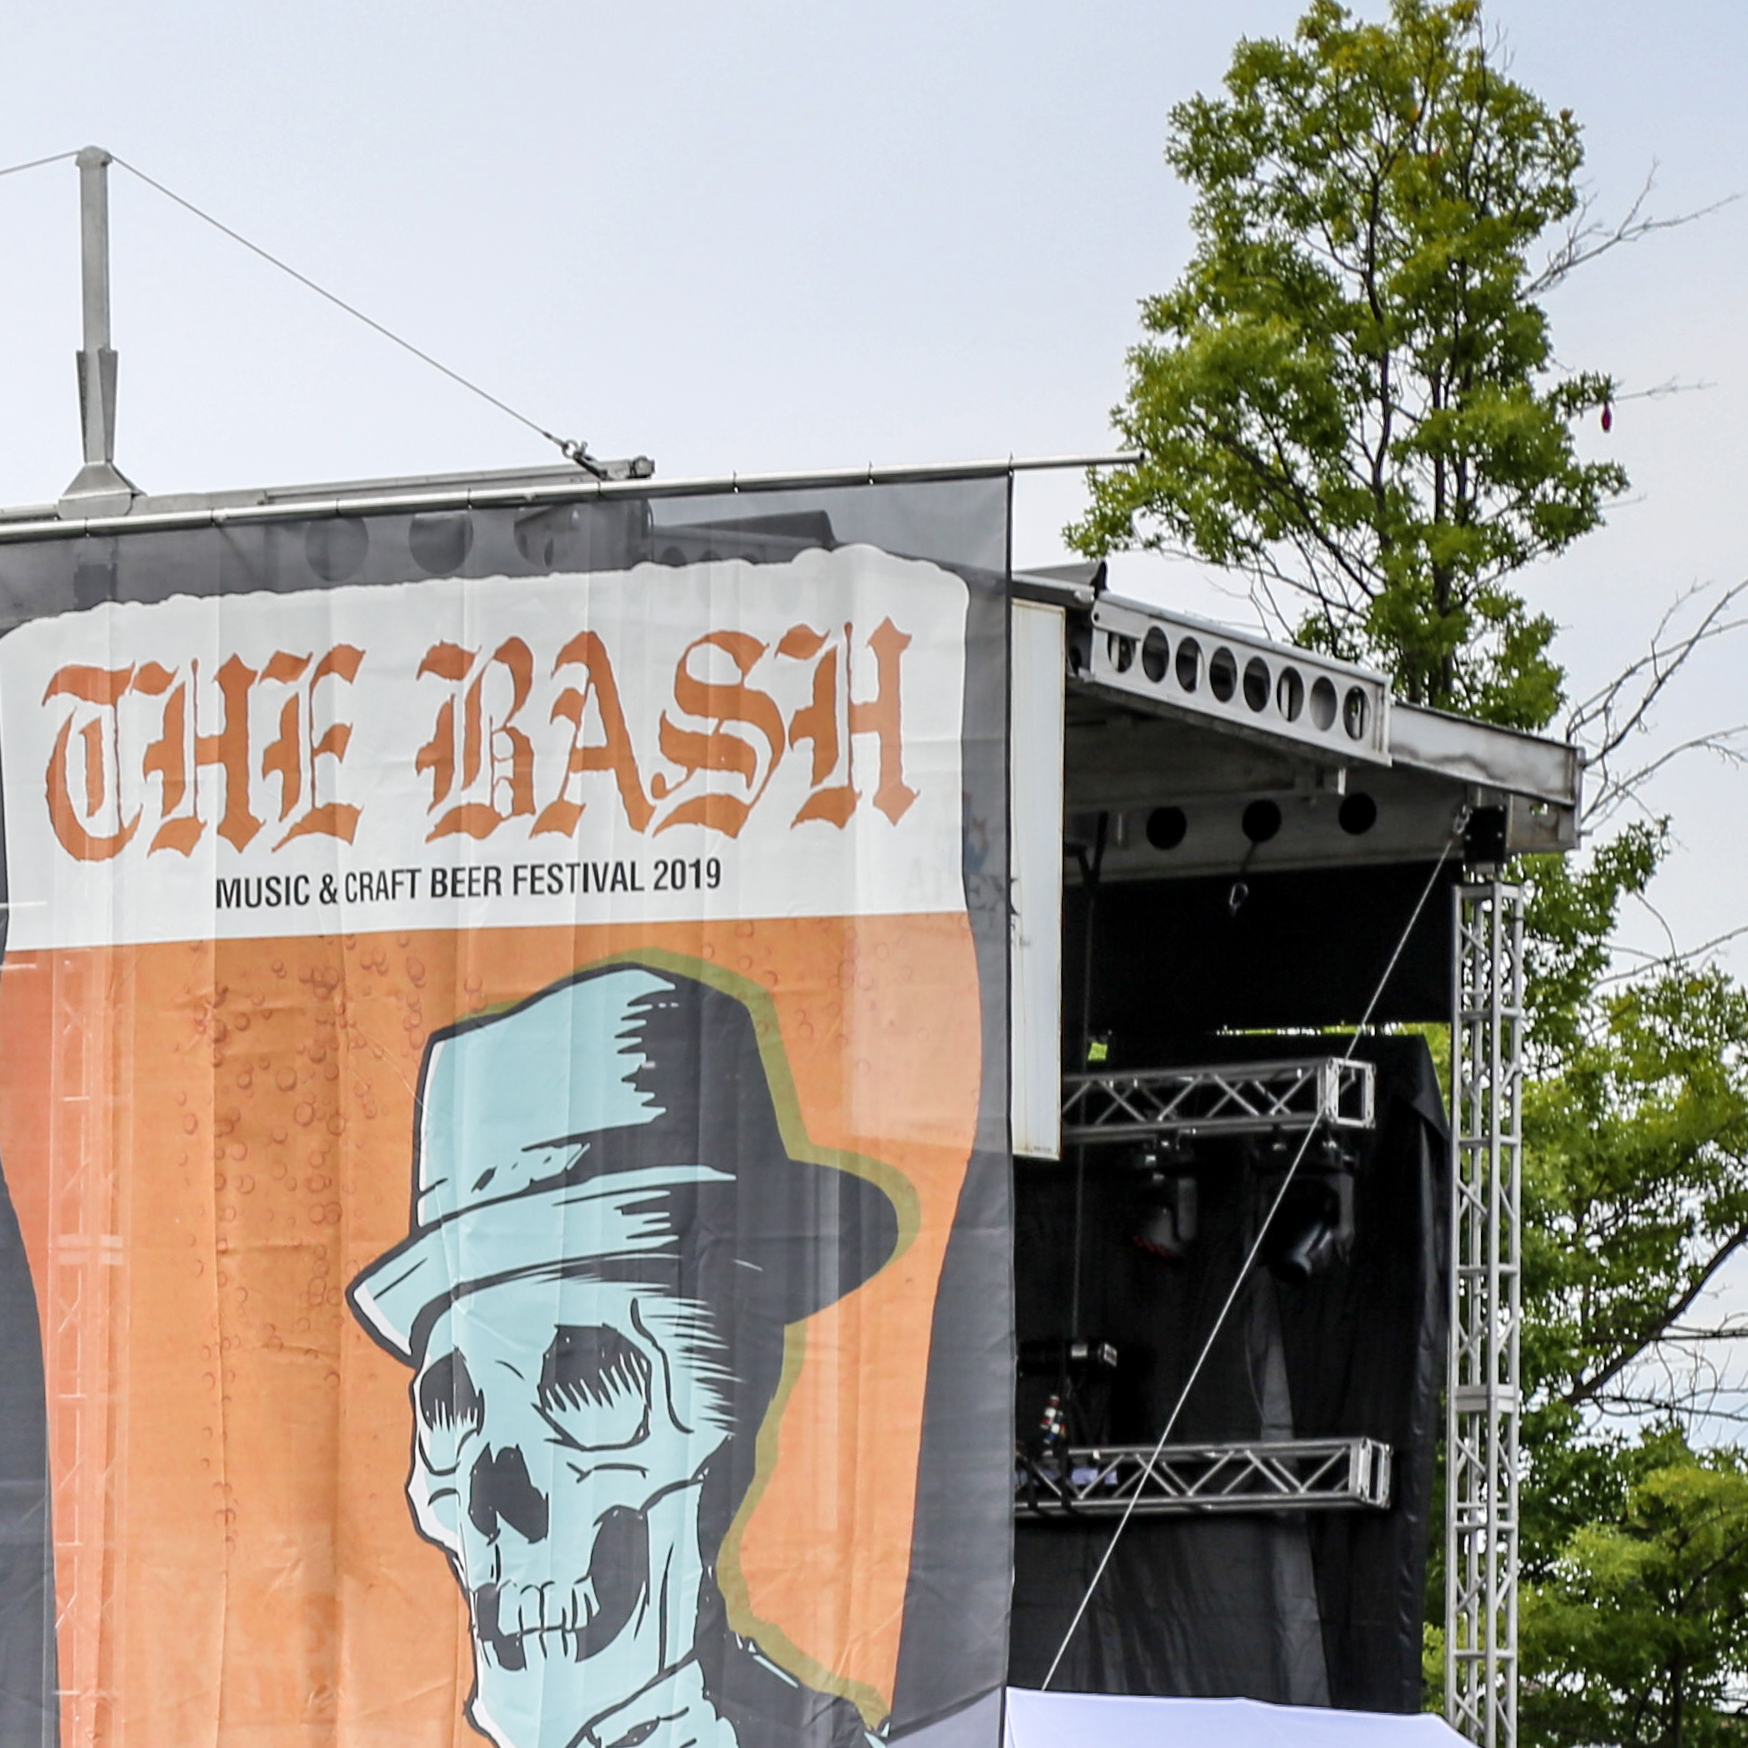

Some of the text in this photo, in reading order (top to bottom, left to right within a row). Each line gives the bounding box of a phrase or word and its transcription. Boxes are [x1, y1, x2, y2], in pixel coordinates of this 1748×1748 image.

[42, 614, 921, 862] THE BASH
[214, 857, 722, 909] MUSIC & CRAFT BEER FESTIVAL 2019
